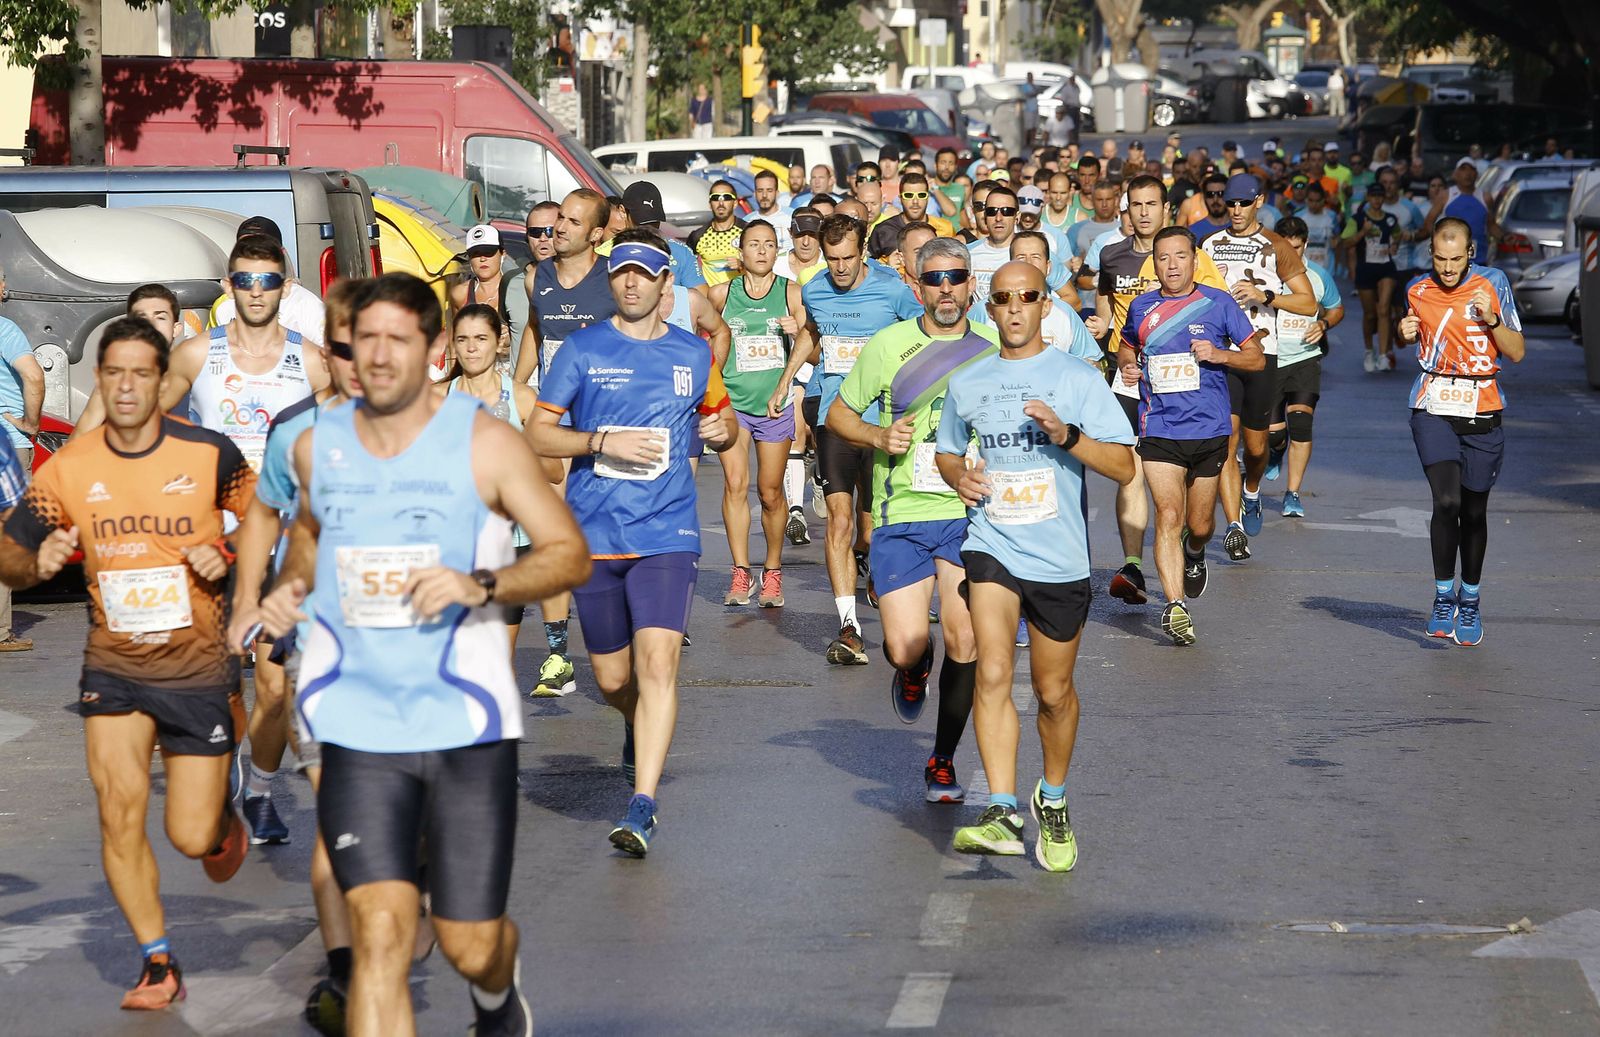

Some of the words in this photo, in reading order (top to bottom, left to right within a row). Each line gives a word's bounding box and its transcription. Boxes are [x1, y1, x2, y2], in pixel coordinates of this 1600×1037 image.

[1214, 244, 1258, 253] COCHINOS
[1213, 253, 1255, 262] RUNNERS
[1116, 274, 1159, 288] bich
[1282, 318, 1307, 329] 592
[747, 344, 778, 358] 301
[597, 366, 635, 375] Santander
[1159, 363, 1196, 379] 776
[672, 371, 693, 397] 091
[1439, 389, 1474, 403] 698
[981, 425, 1052, 453] nerja
[993, 453, 1044, 465] ATLETISMO
[1002, 483, 1049, 505] 447
[91, 513, 195, 540] inacua
[123, 583, 180, 609] 424
